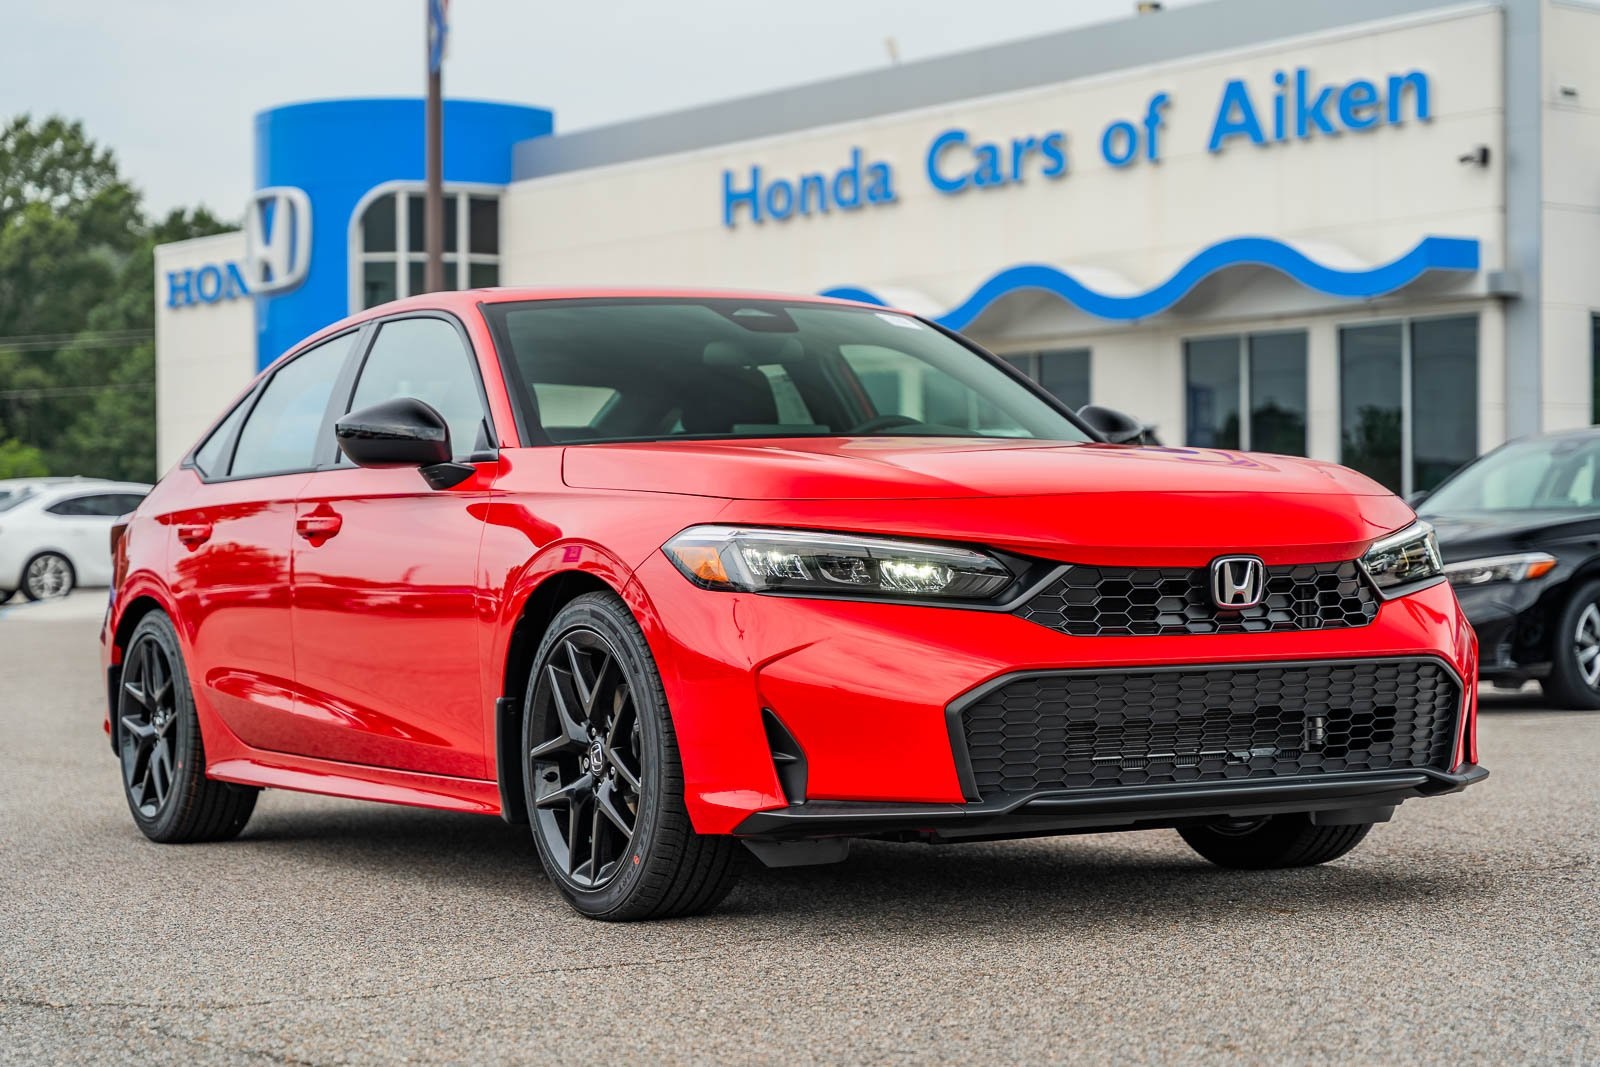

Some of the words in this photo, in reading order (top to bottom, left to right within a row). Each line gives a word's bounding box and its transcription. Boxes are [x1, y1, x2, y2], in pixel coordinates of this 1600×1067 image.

[721, 147, 897, 228] Honda
[926, 128, 1067, 195] Cars
[1101, 93, 1169, 167] of
[1207, 68, 1432, 153] Aiken
